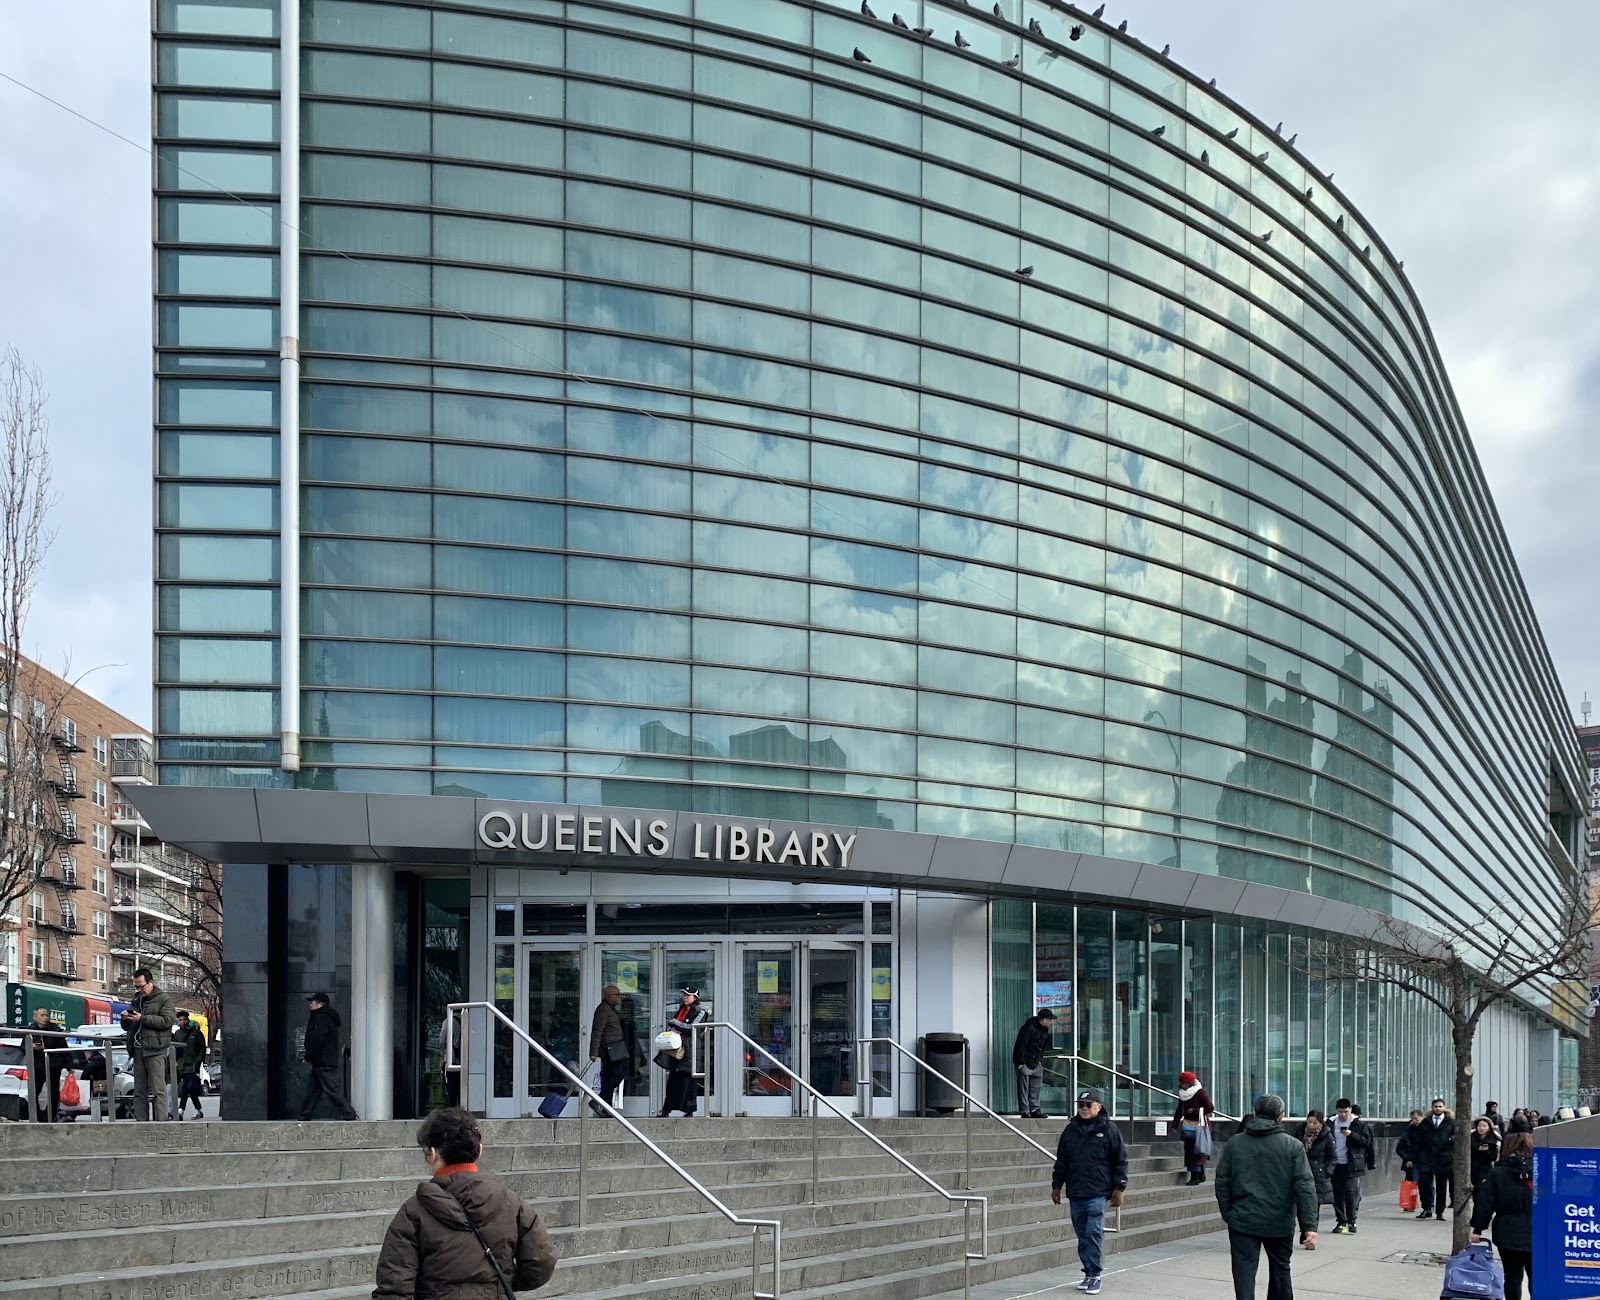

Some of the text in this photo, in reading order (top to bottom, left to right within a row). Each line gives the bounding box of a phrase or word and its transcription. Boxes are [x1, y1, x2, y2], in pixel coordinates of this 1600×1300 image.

[478, 810, 857, 868] QUEENS LIBRARY
[139, 1128, 202, 1150] 西遊記
[227, 1126, 371, 1147] Journey to the West
[1, 1196, 213, 1228] of the Eastern World
[1564, 1203, 1595, 1217] Get
[1564, 1219, 1600, 1233] Tick
[346, 1259, 374, 1277] The
[635, 1250, 752, 1277] Le Petit Chaperon Rouge
[130, 1276, 212, 1300] Leyenda
[222, 1275, 243, 1292] de
[253, 1265, 322, 1288] Cantuña
[690, 1284, 706, 1300] the
[711, 1284, 728, 1300] Star
